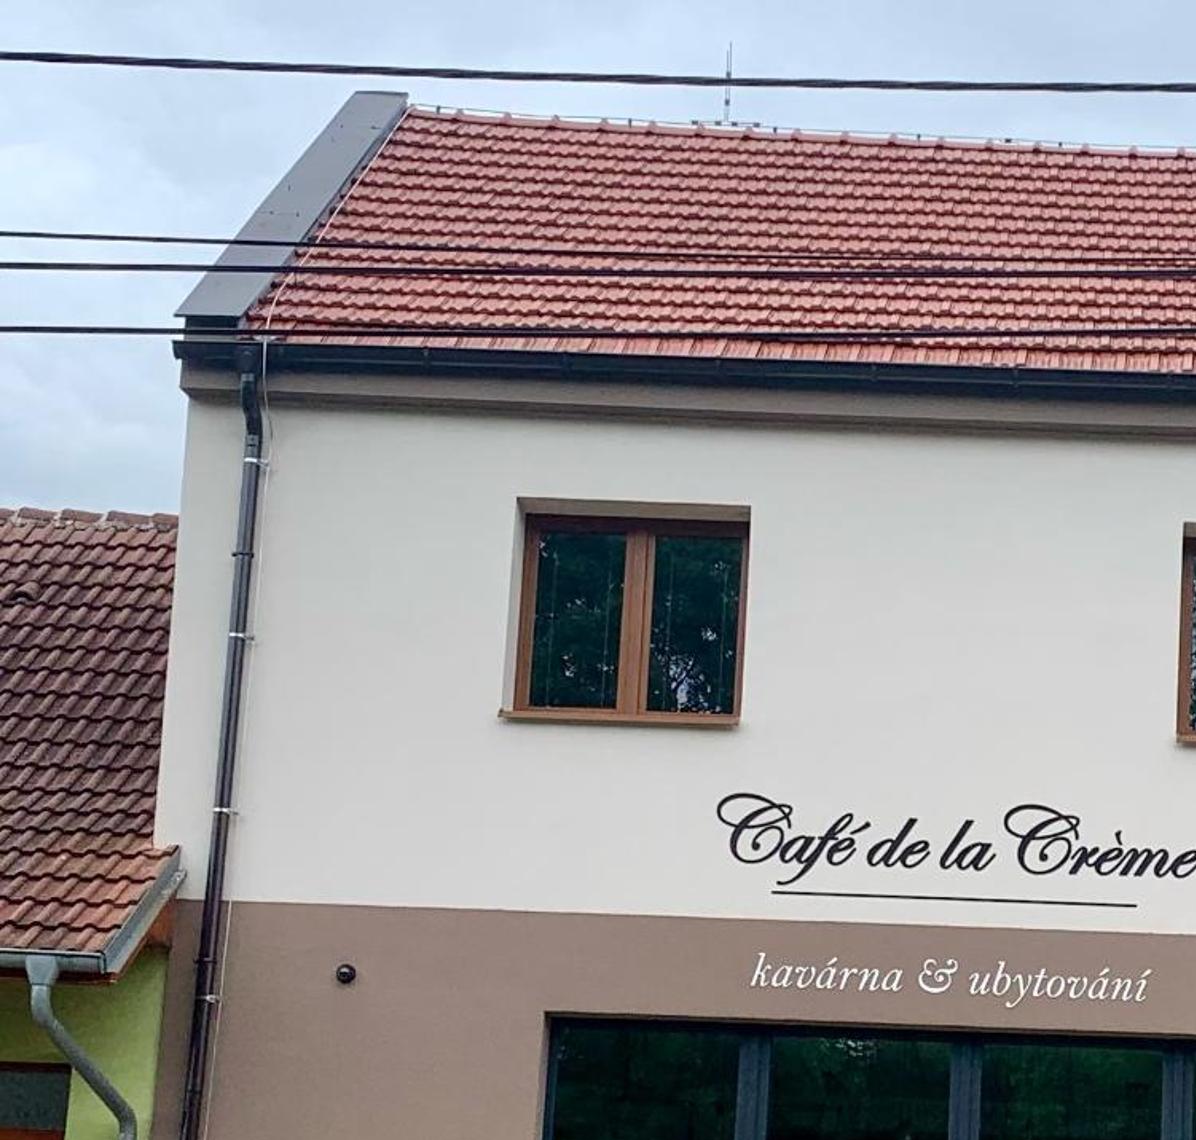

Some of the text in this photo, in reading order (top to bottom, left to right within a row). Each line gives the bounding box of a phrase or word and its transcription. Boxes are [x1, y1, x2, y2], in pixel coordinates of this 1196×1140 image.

[716, 792, 871, 886] Café
[866, 817, 931, 869] de
[938, 819, 997, 872] la
[750, 952, 1152, 1008] kavárna & ubytování
